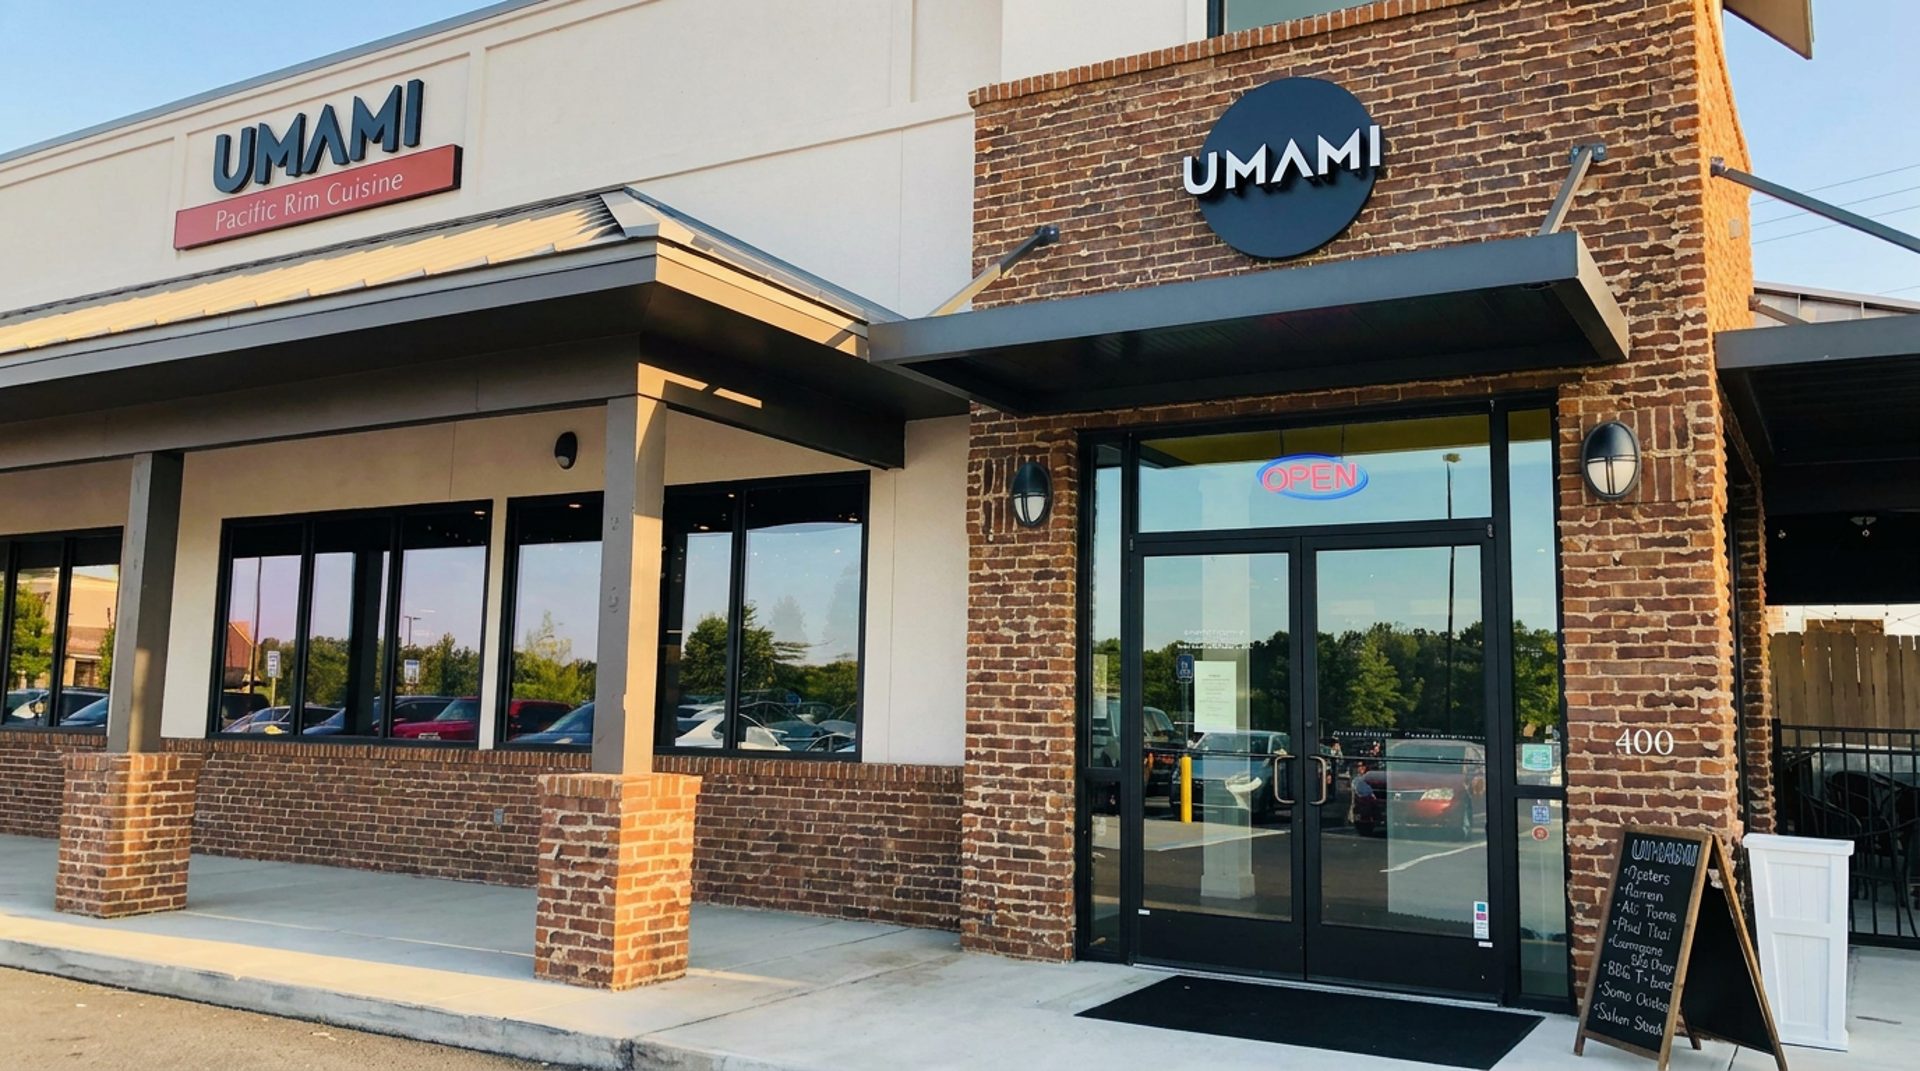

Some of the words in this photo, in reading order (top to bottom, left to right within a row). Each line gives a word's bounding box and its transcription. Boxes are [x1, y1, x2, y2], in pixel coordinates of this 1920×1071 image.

[213, 79, 424, 194] UMAMI
[1183, 124, 1381, 195] UMAMI
[215, 200, 277, 232] Pacific
[284, 191, 319, 216] Rim
[327, 173, 404, 206] Cuisine
[1262, 463, 1356, 493] OPEN
[1615, 728, 1674, 755] 400
